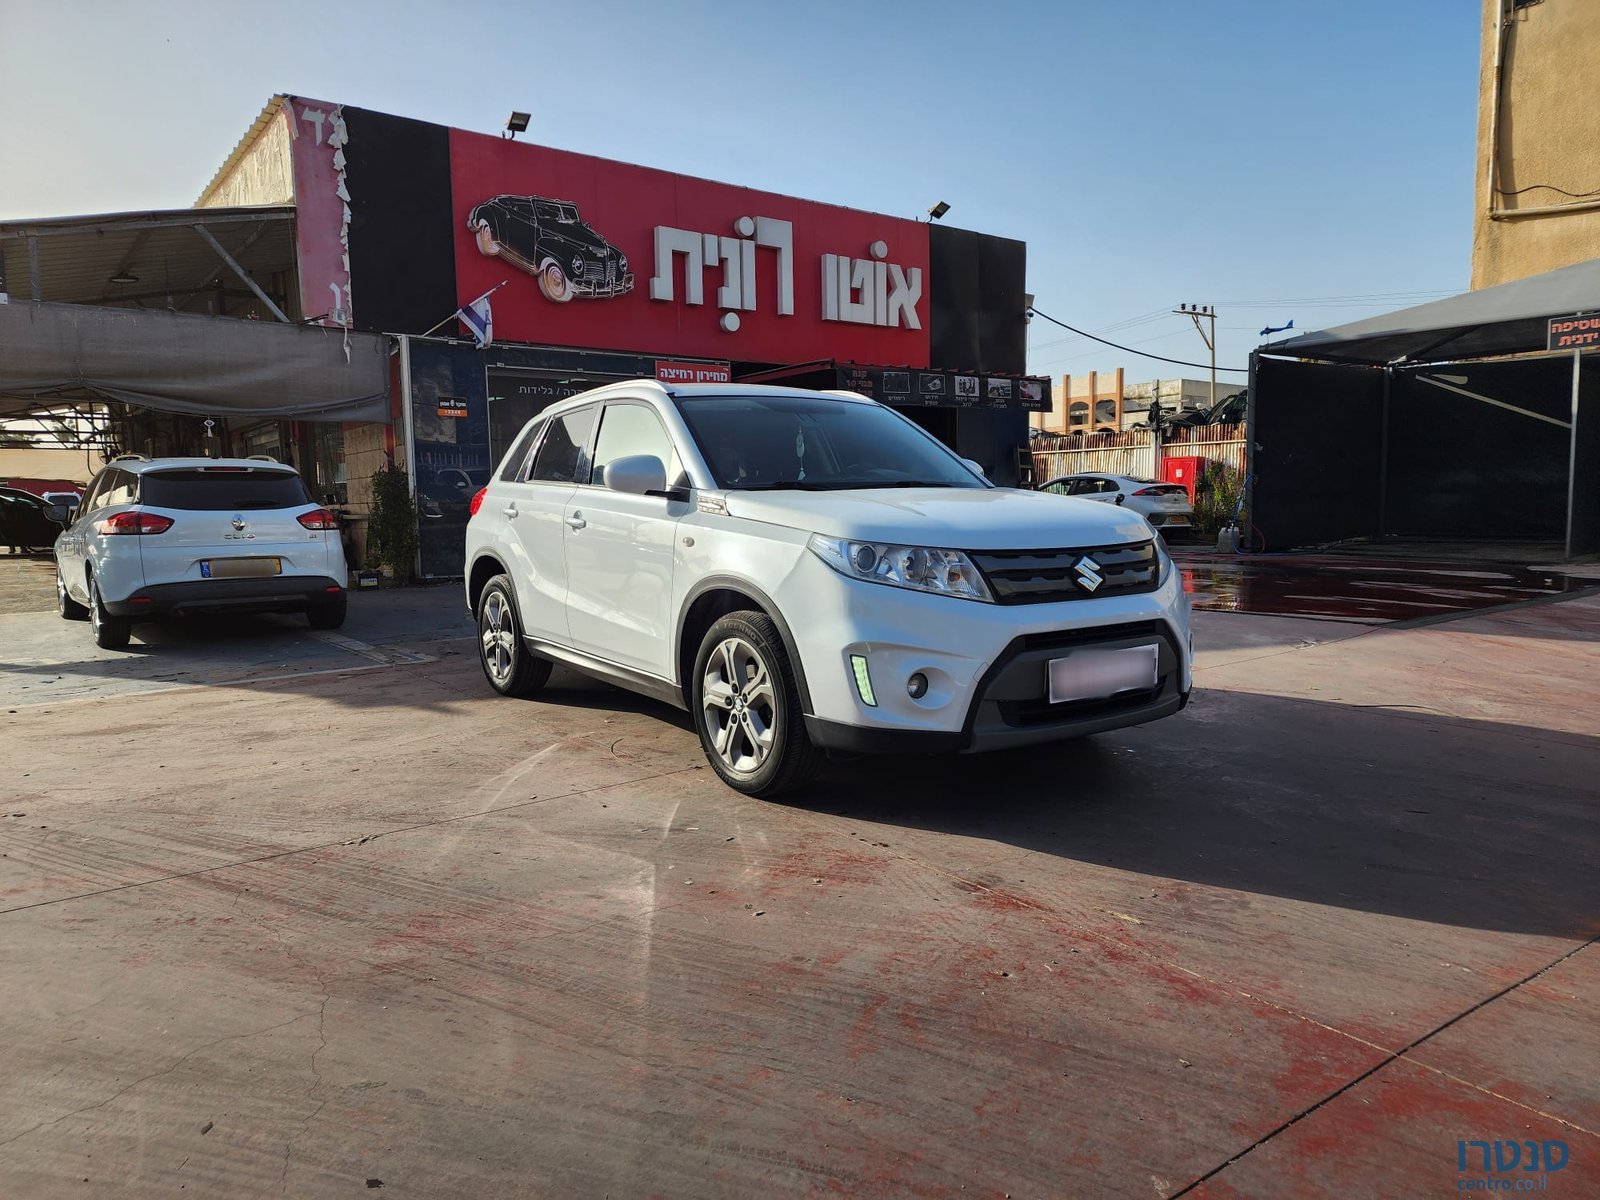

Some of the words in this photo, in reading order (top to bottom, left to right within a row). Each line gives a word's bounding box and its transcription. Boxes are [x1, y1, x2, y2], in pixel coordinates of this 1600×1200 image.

[1558, 332, 1599, 346] ידנית
[660, 368, 693, 379] רחיצה
[696, 370, 728, 382] מחירון
[518, 385, 554, 395] גלידות
